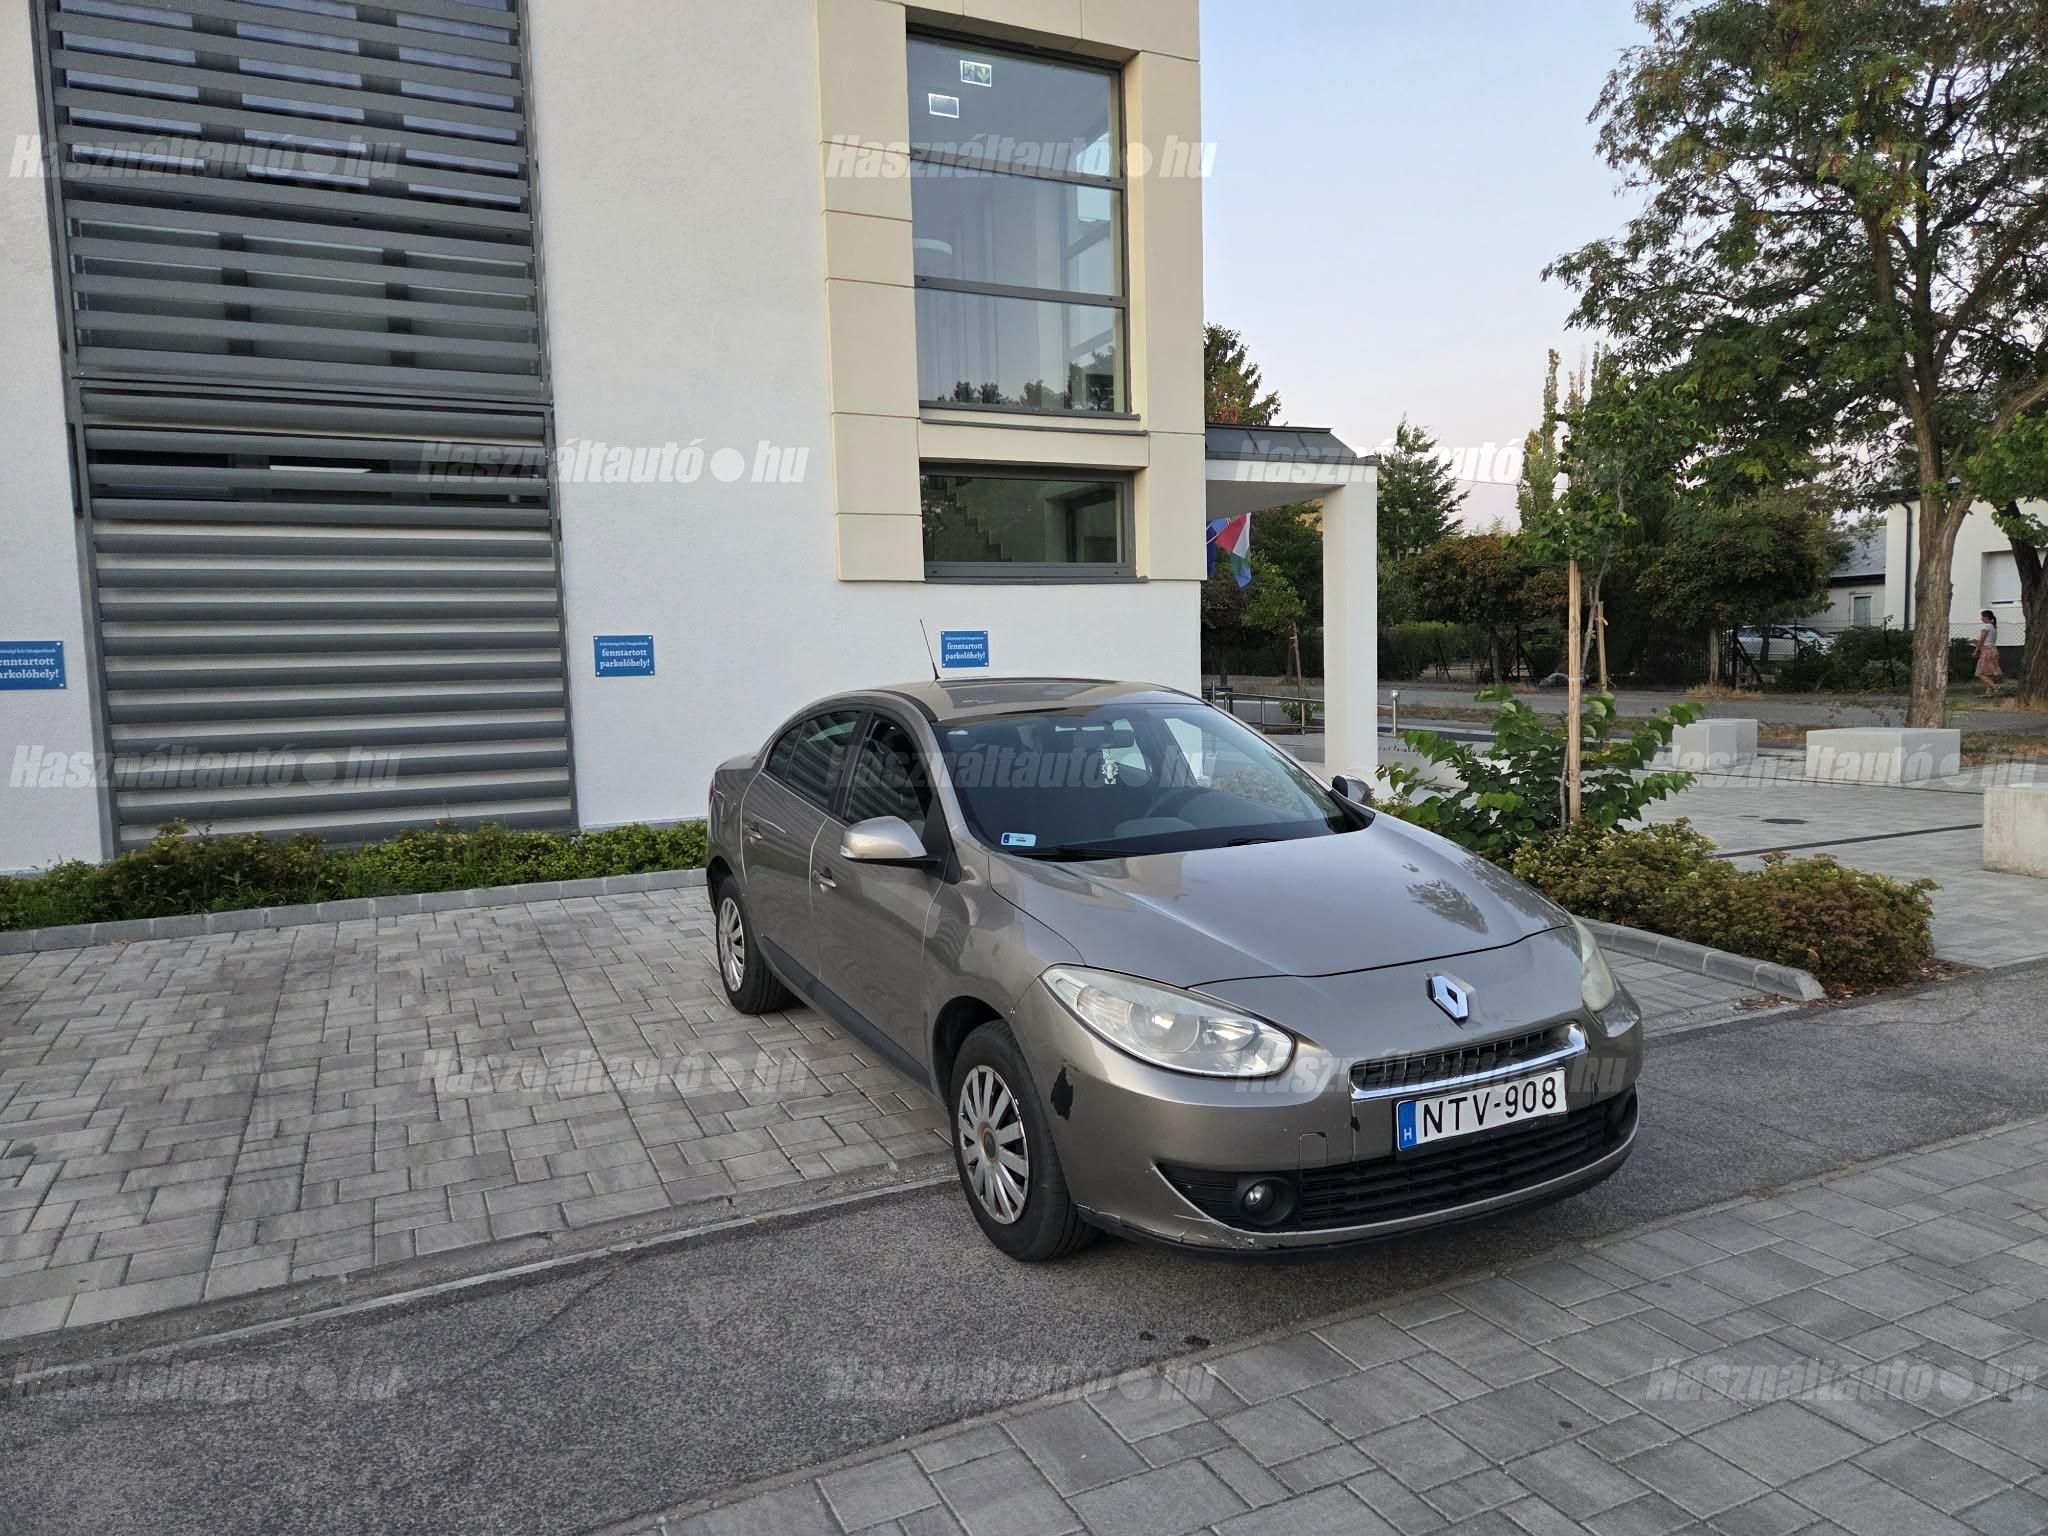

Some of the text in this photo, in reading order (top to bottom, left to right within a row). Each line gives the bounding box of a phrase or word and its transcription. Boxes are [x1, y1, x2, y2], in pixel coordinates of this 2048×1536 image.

[947, 642, 984, 651] fenntartott
[601, 648, 648, 657] fenntartott
[945, 651, 986, 662] parkolóhely!
[600, 658, 650, 669] parkolóhely!
[1423, 1076, 1557, 1138] NTV-908
[1403, 1127, 1413, 1141] H
